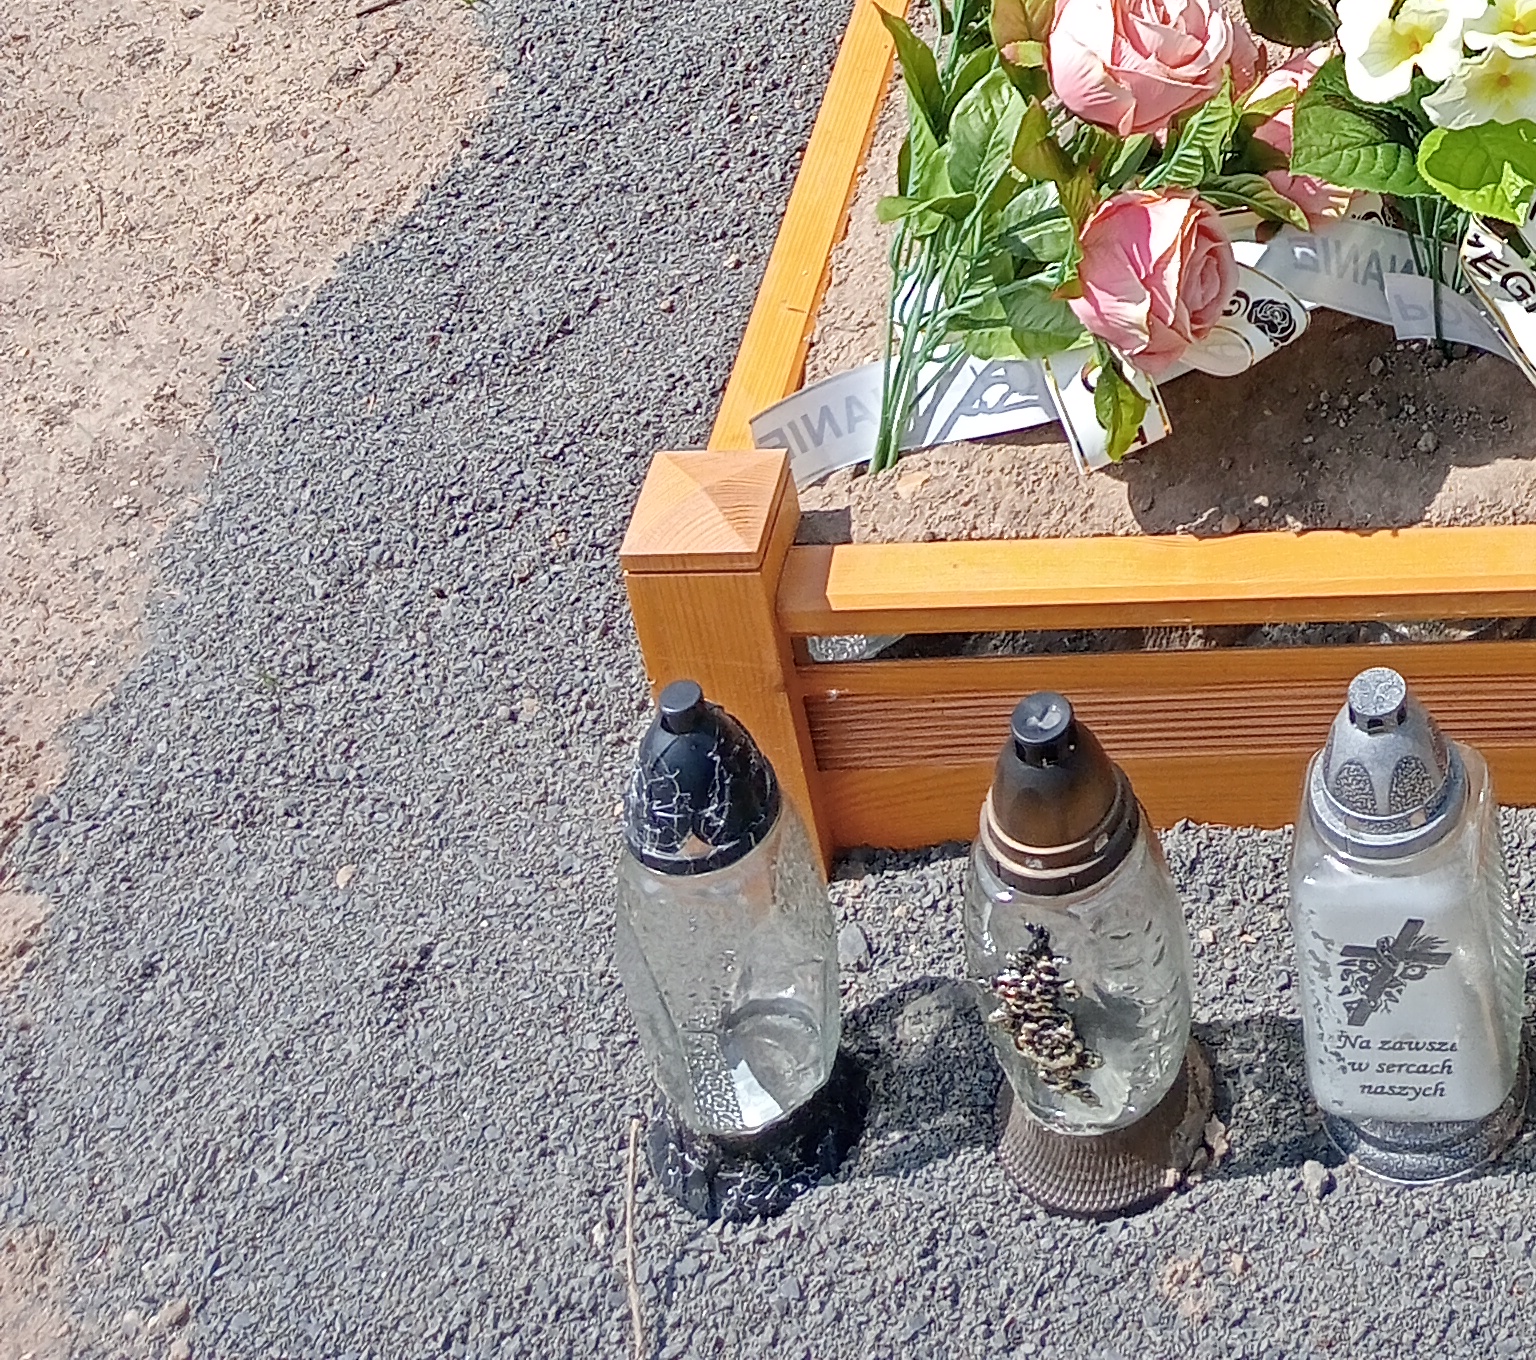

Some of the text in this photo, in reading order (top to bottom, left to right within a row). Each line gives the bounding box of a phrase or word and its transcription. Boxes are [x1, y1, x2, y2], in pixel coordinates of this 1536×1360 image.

[1337, 1034, 1372, 1050] Na
[1347, 1058, 1454, 1075] w sercach
[1360, 1081, 1446, 1101] naszych
